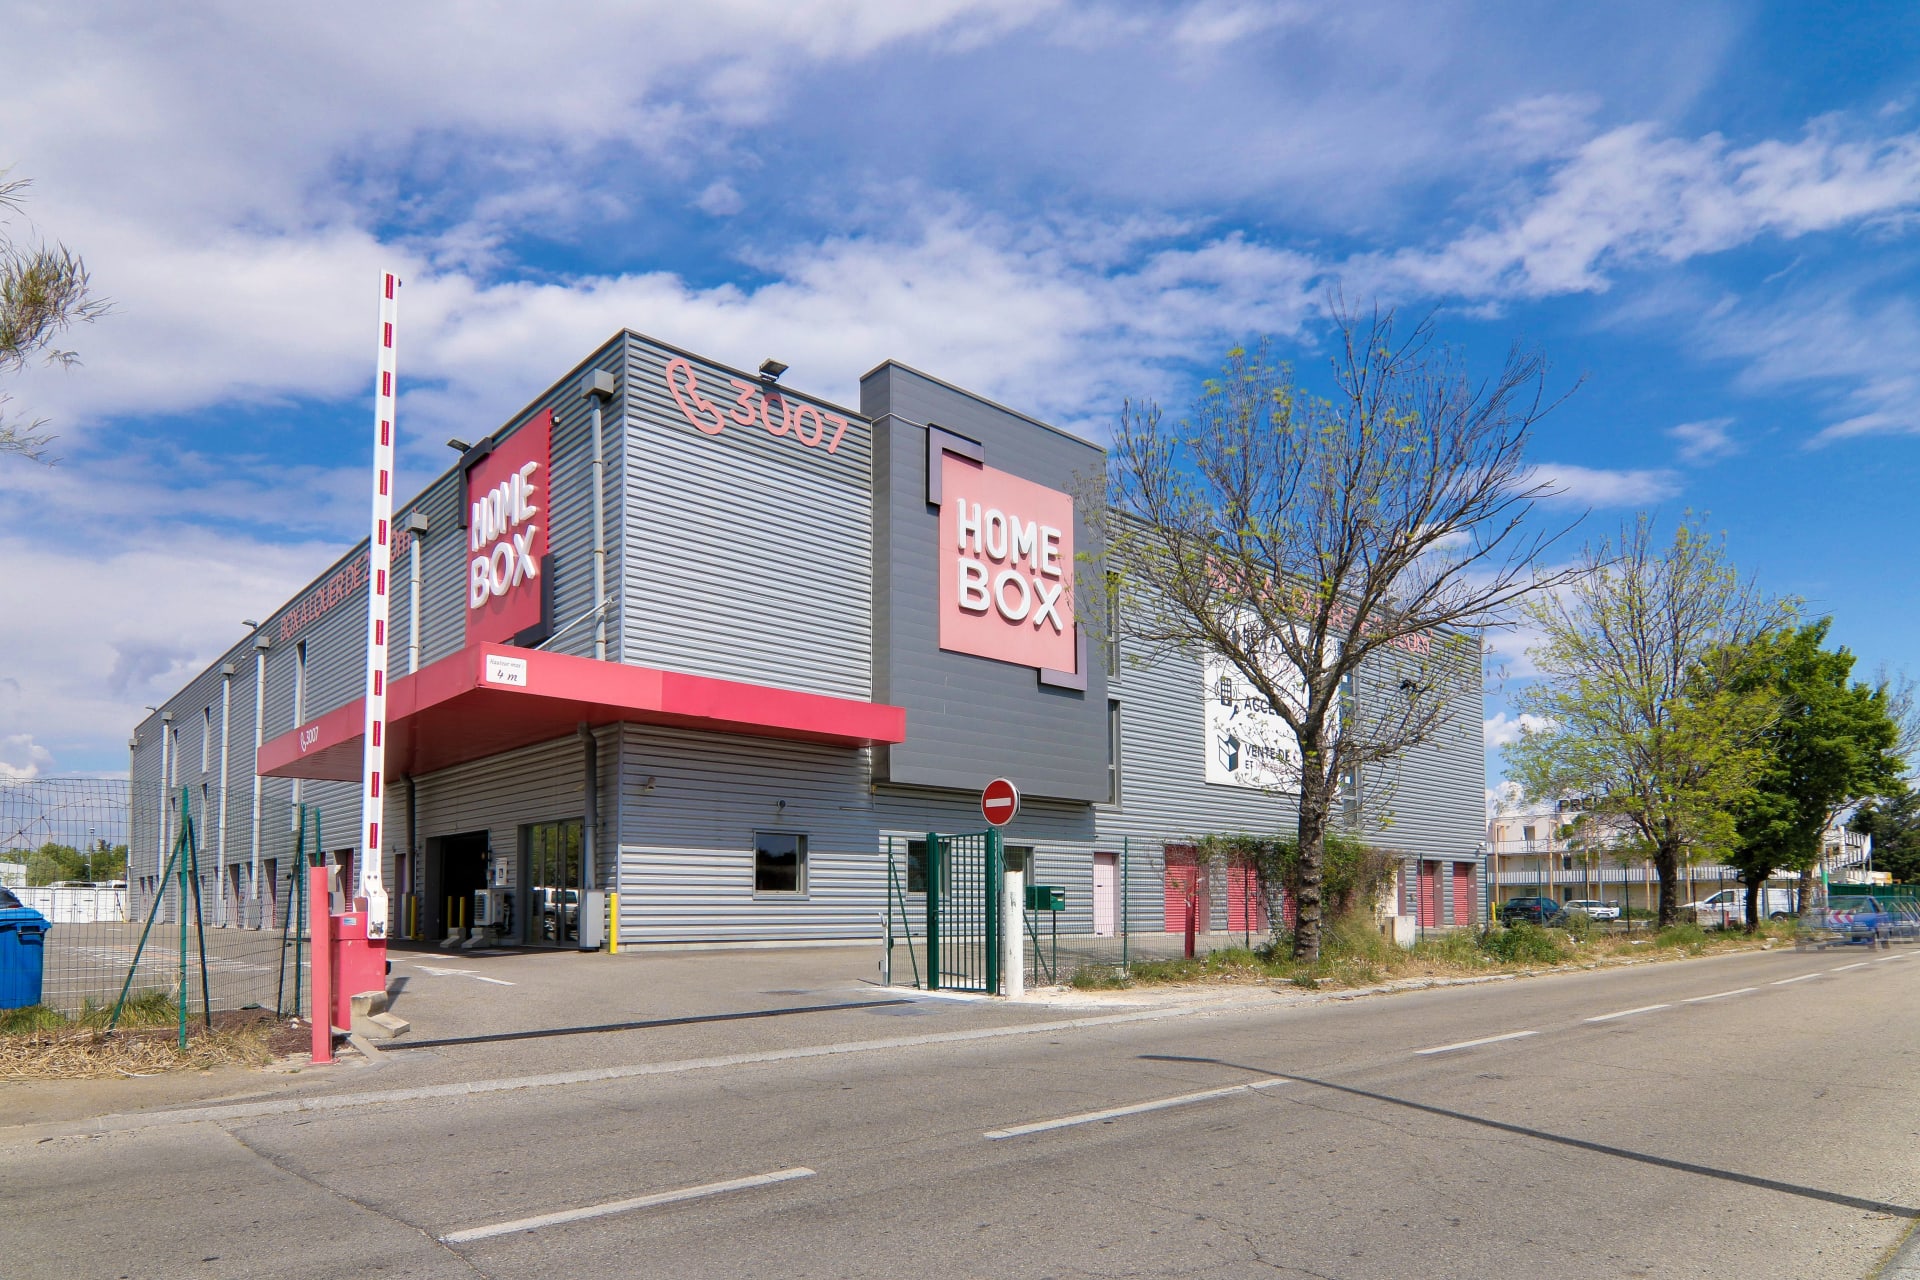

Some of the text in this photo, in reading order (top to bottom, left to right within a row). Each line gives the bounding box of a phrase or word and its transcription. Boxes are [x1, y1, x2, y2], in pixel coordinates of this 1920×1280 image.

[729, 379, 848, 455] 3007
[471, 461, 538, 552] HOME
[957, 498, 1063, 577] HOME
[309, 572, 345, 619] LOUER
[345, 556, 362, 597] DE
[470, 524, 537, 609] BOX
[957, 557, 1064, 631] BOX
[305, 725, 319, 745] 3007
[1244, 743, 1276, 760] VENTE
